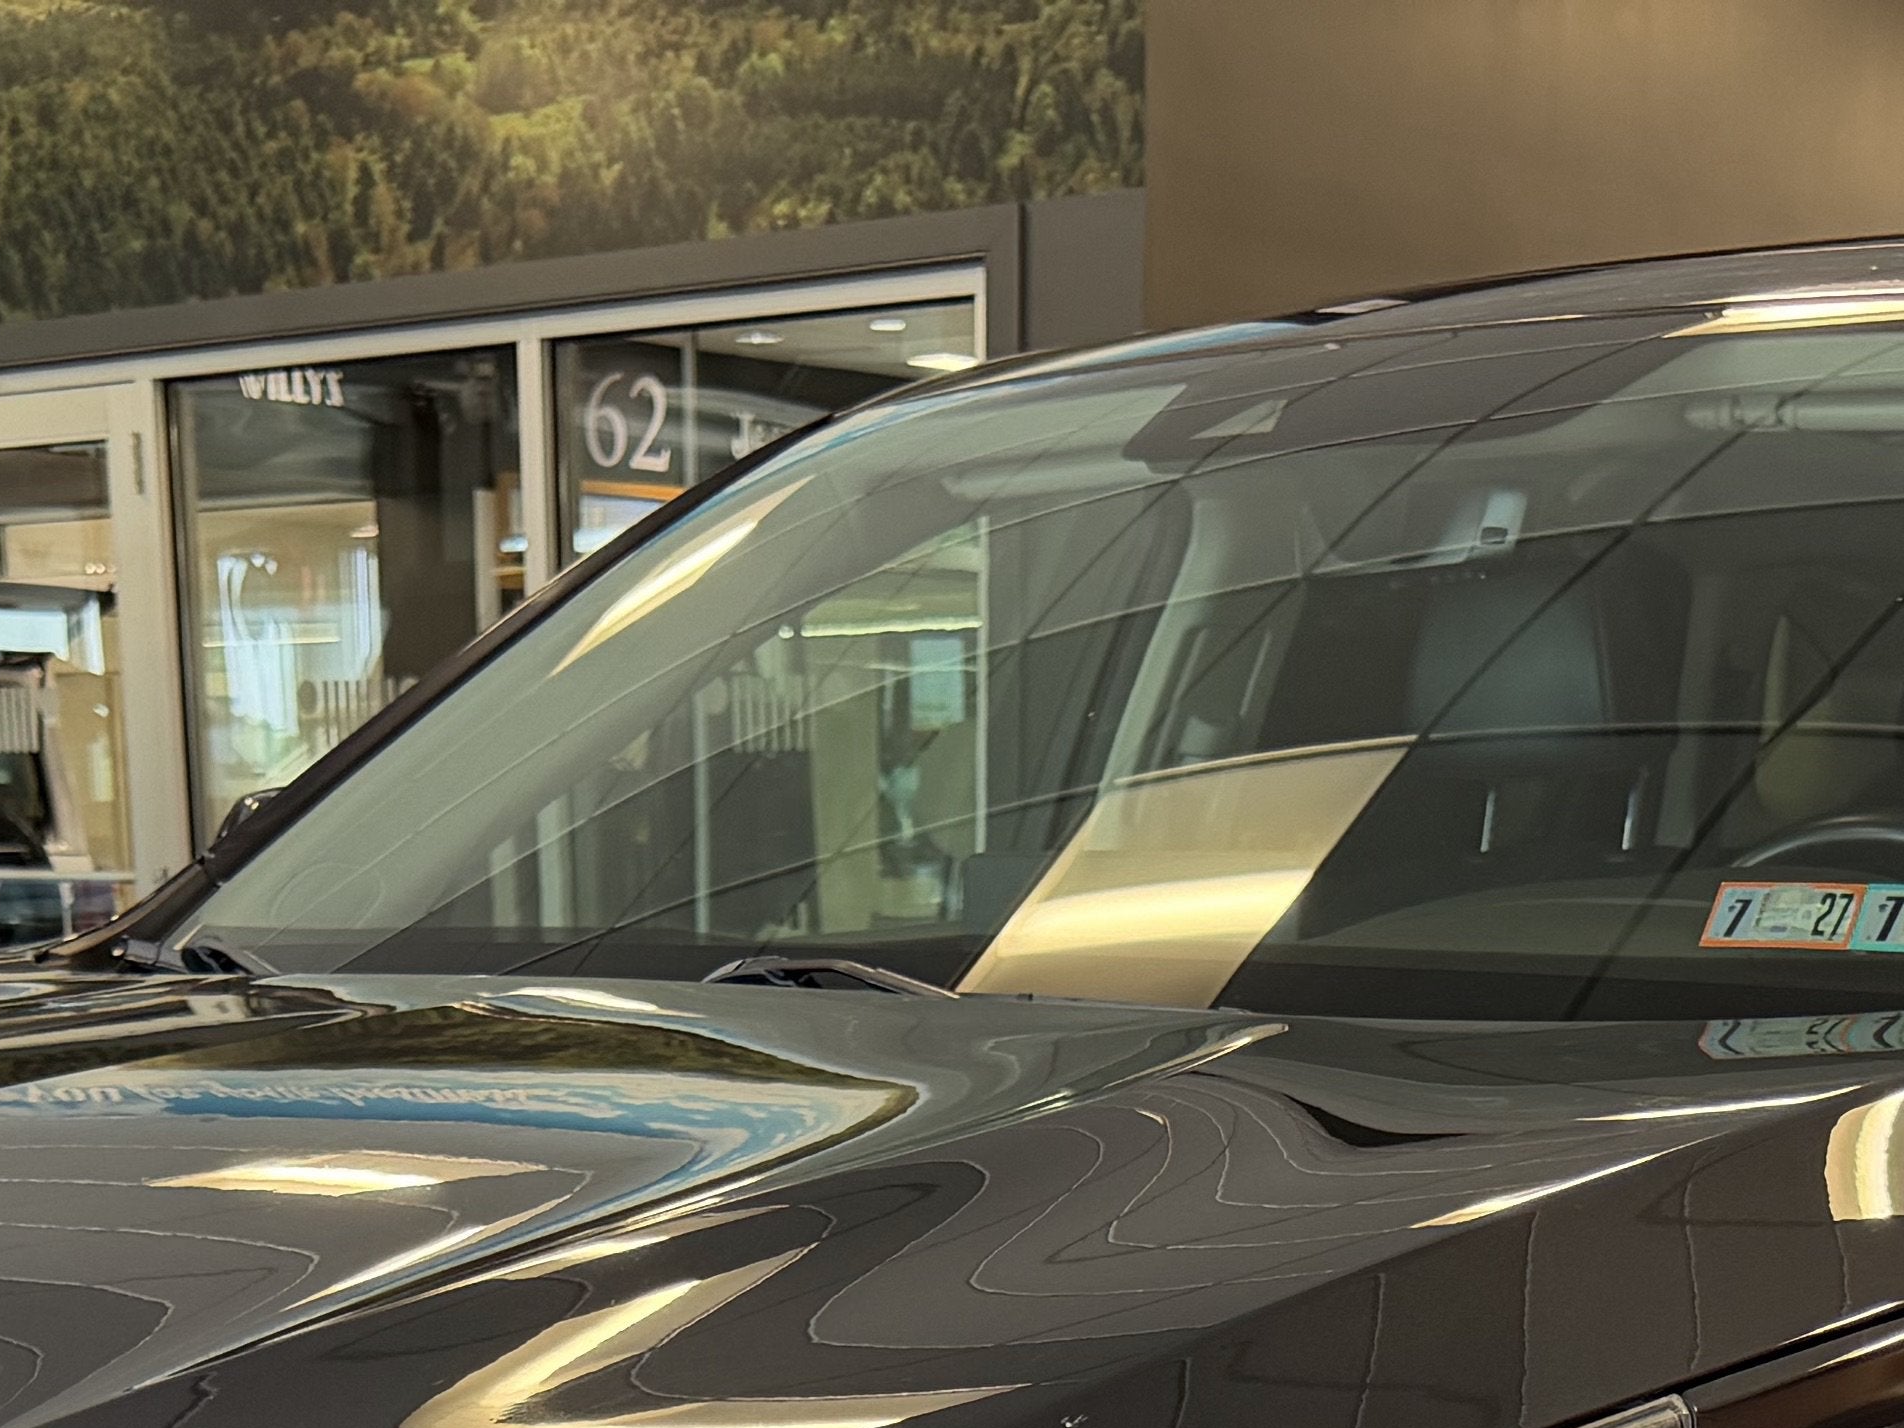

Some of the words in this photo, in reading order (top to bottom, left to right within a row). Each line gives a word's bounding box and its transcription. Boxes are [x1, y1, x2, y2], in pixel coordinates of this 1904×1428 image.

[585, 371, 672, 472] 62
[1723, 898, 1753, 938] 7
[1810, 892, 1855, 941] 27
